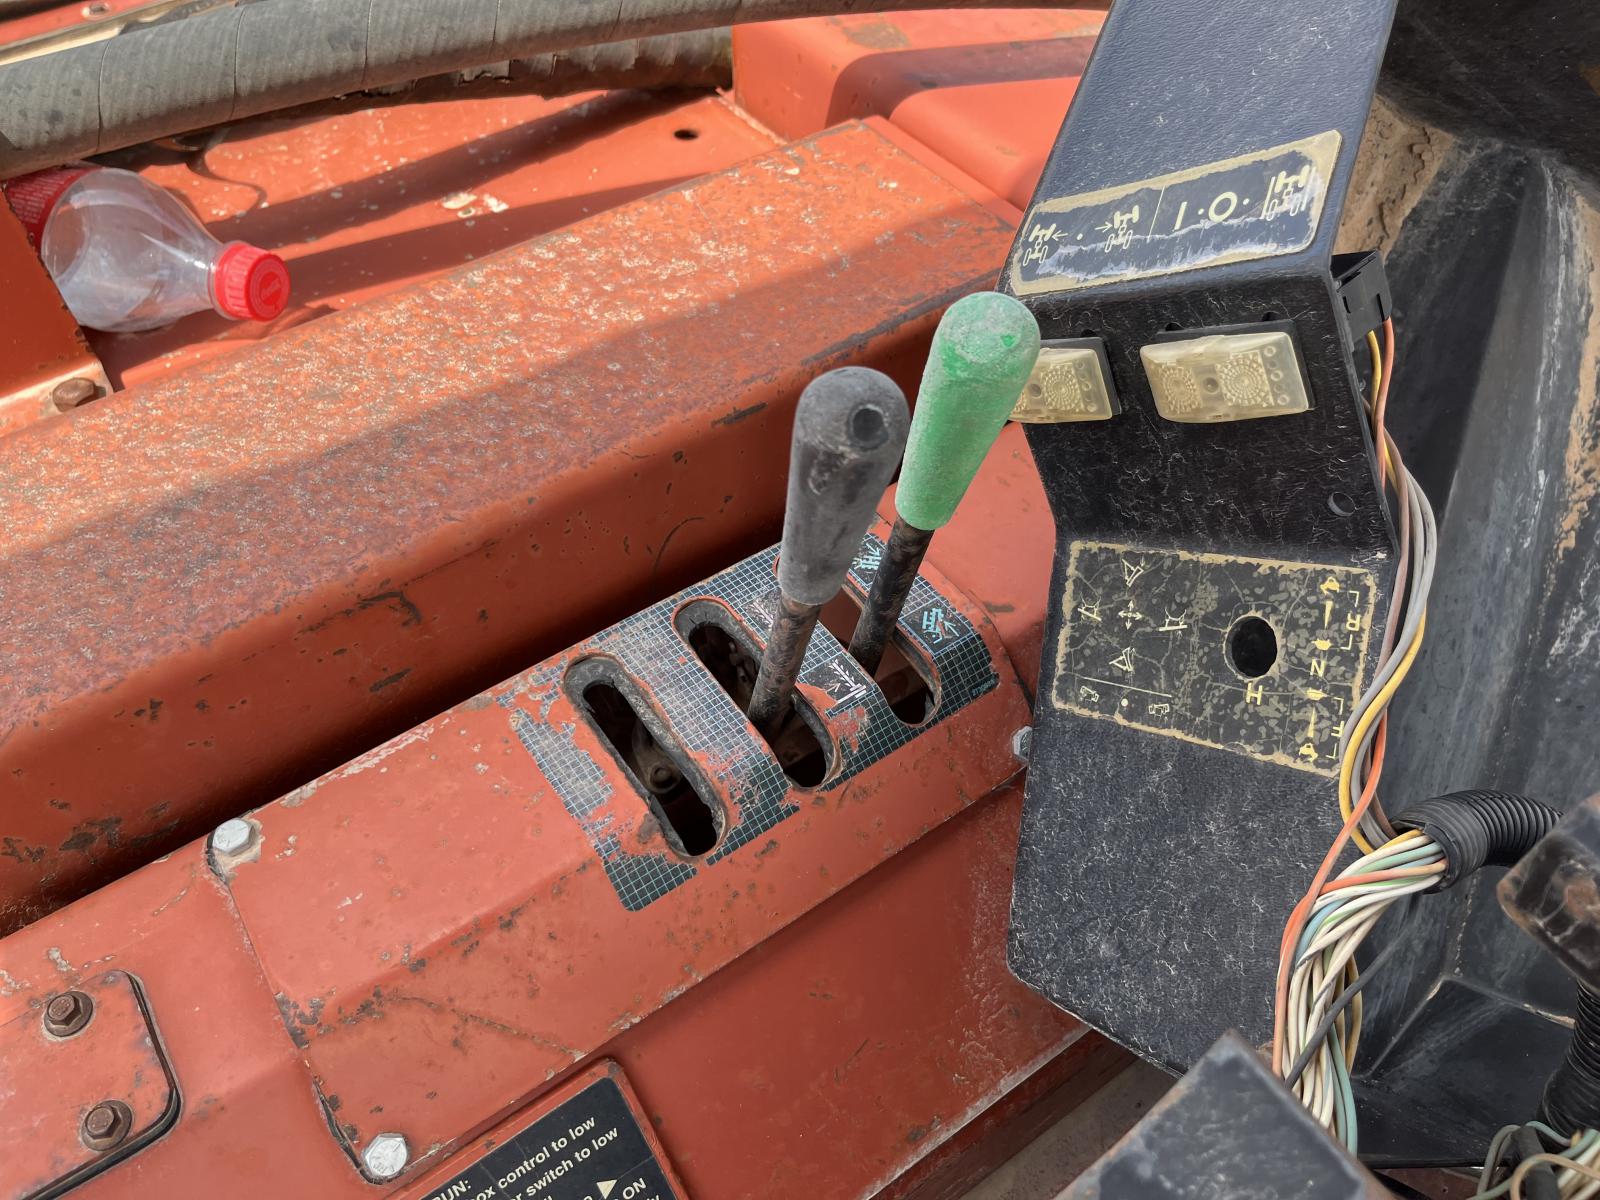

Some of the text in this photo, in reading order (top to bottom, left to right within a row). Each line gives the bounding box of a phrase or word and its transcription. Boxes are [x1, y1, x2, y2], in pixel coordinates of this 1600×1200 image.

[1346, 613, 1361, 631] R
[1310, 658, 1326, 677] N
[1245, 682, 1263, 706] H
[1330, 720, 1345, 738] F
[498, 1146, 551, 1189] control
[551, 1137, 568, 1152] to
[568, 1117, 596, 1140] low
[526, 1127, 618, 1197] switch to low
[622, 1177, 647, 1200] ON
